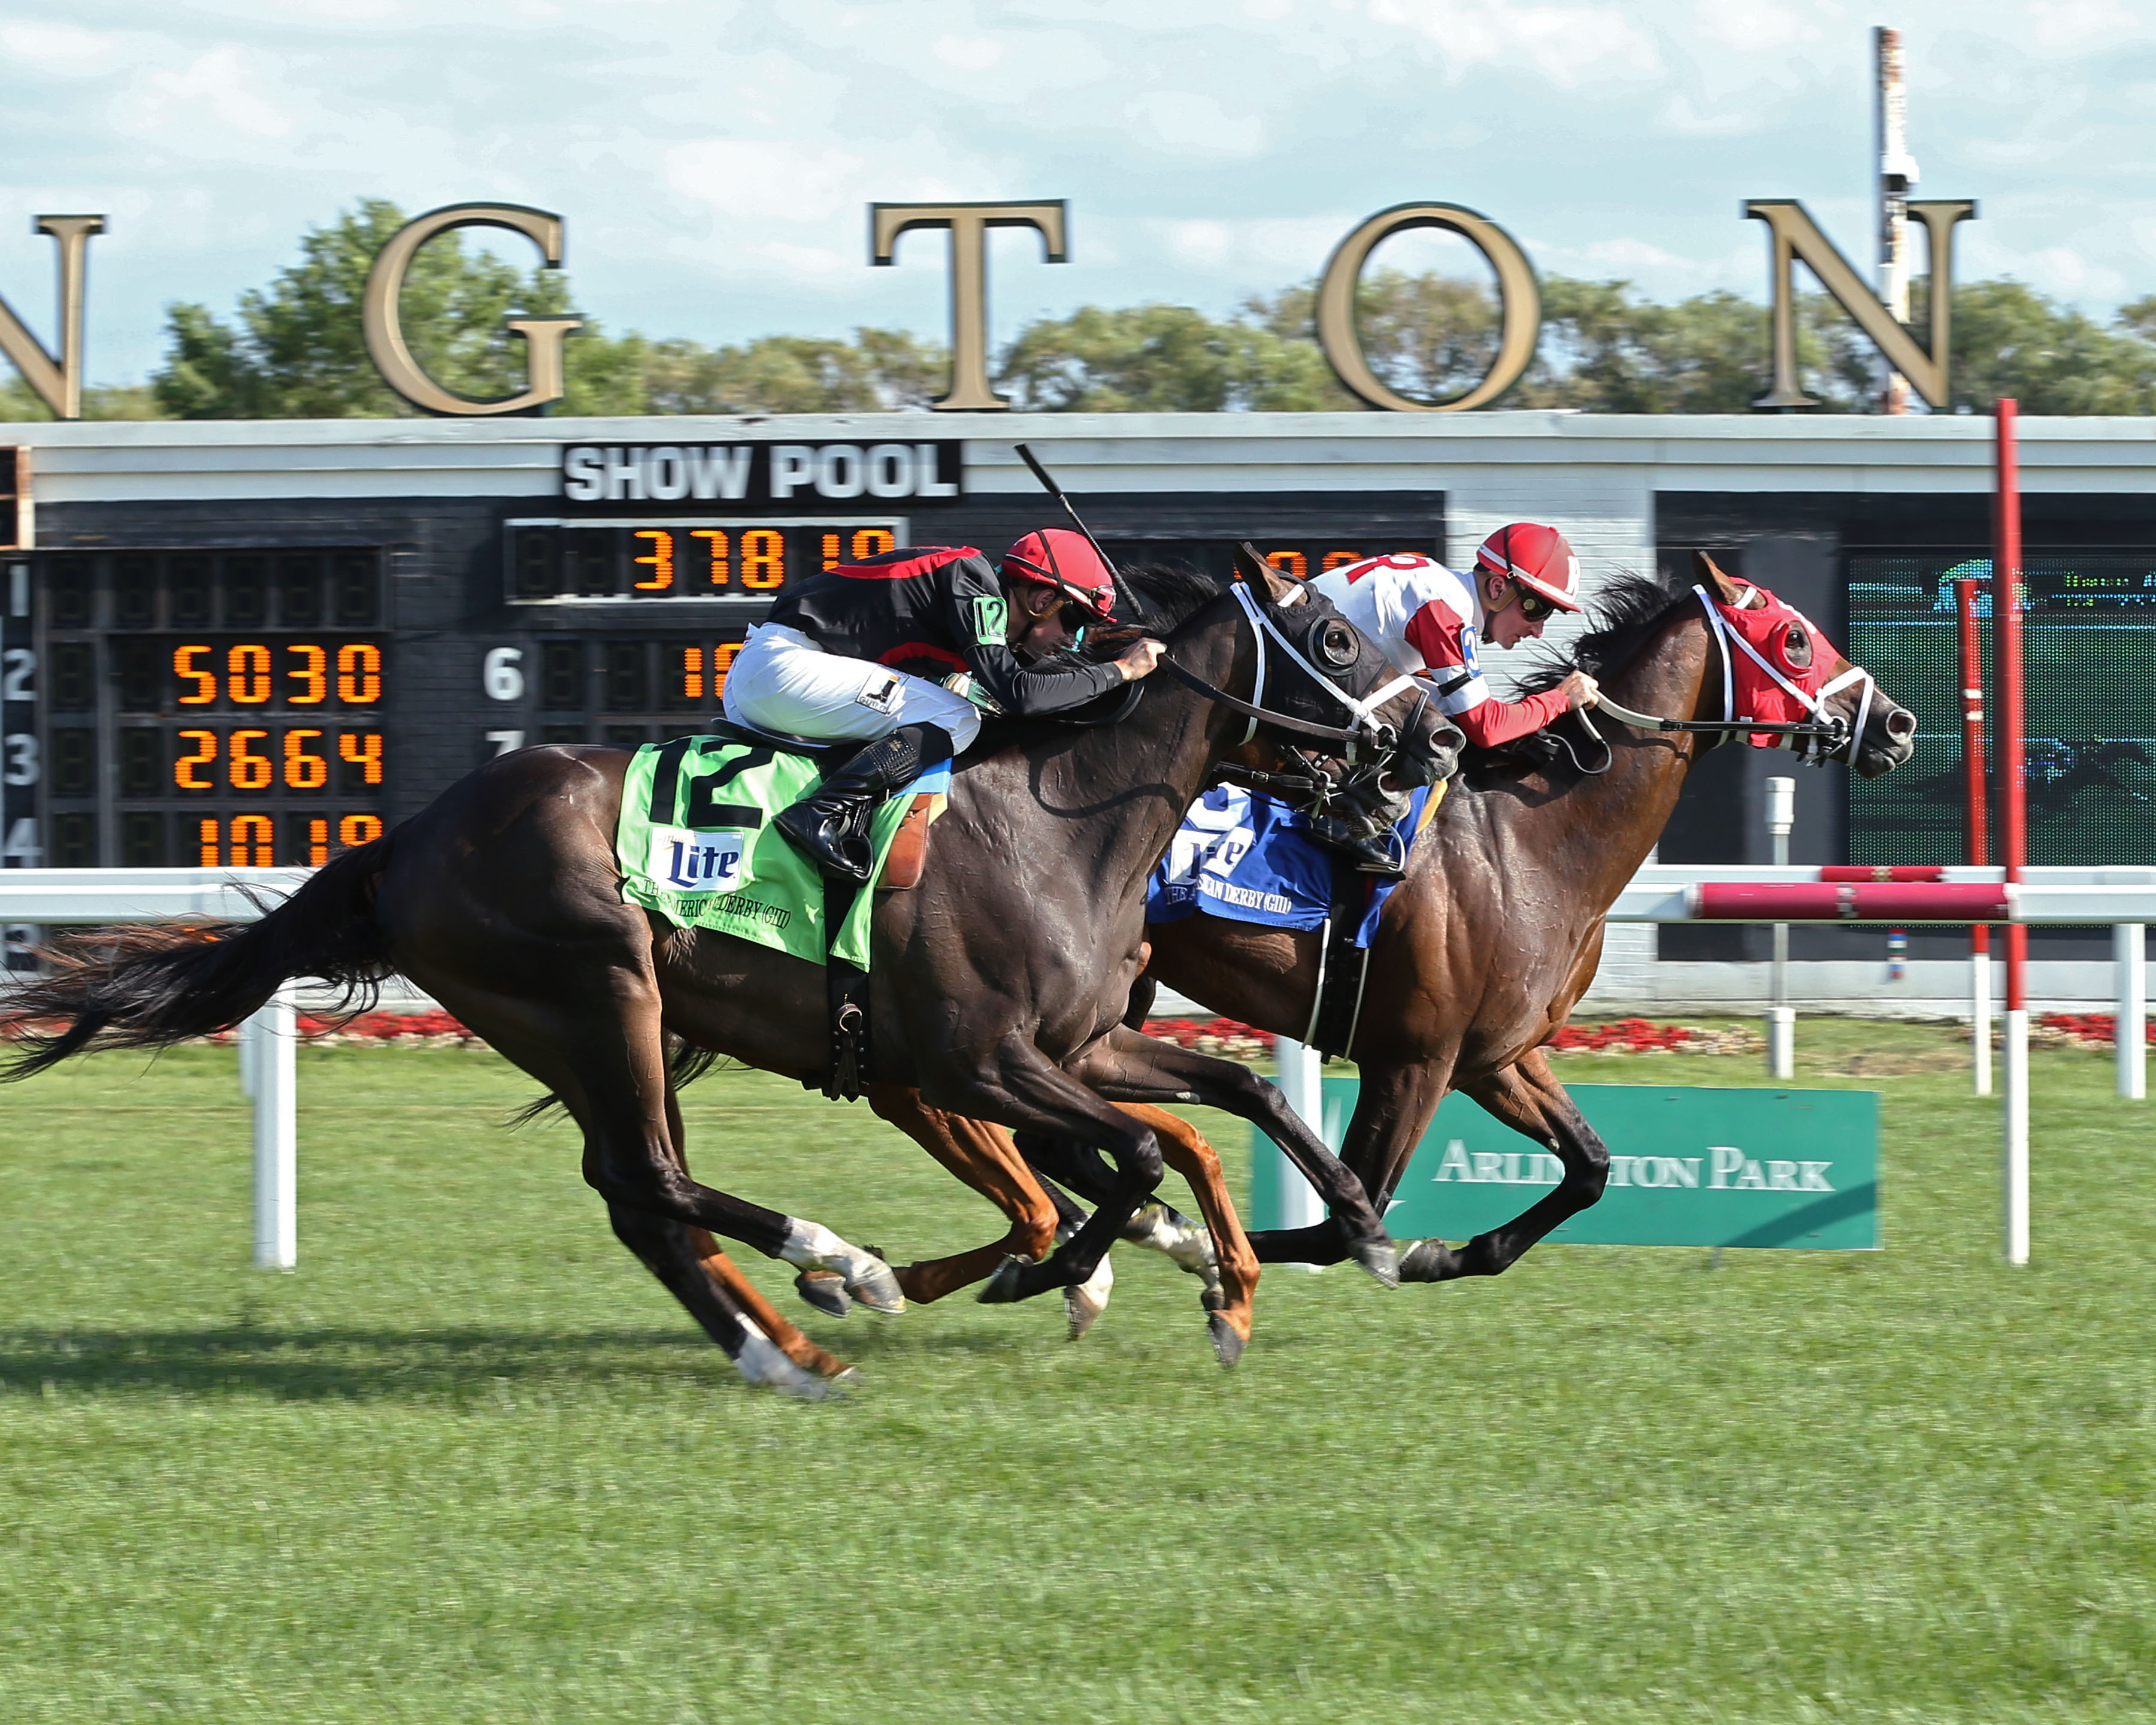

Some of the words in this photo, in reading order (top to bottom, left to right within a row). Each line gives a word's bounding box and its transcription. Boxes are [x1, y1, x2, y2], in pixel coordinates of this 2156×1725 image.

[564, 445, 753, 501] SHOW
[769, 444, 958, 498] POOL
[975, 601, 1004, 638] 12
[2, 647, 38, 701] 2
[173, 644, 381, 704] 5030
[483, 647, 525, 701] 6
[3, 733, 41, 787] 3
[174, 730, 383, 789] 2664
[649, 736, 777, 830] 12
[2, 818, 43, 868] 4
[667, 840, 739, 888] Lite
[717, 895, 763, 919] DERBY
[1224, 882, 1264, 910] DERBY
